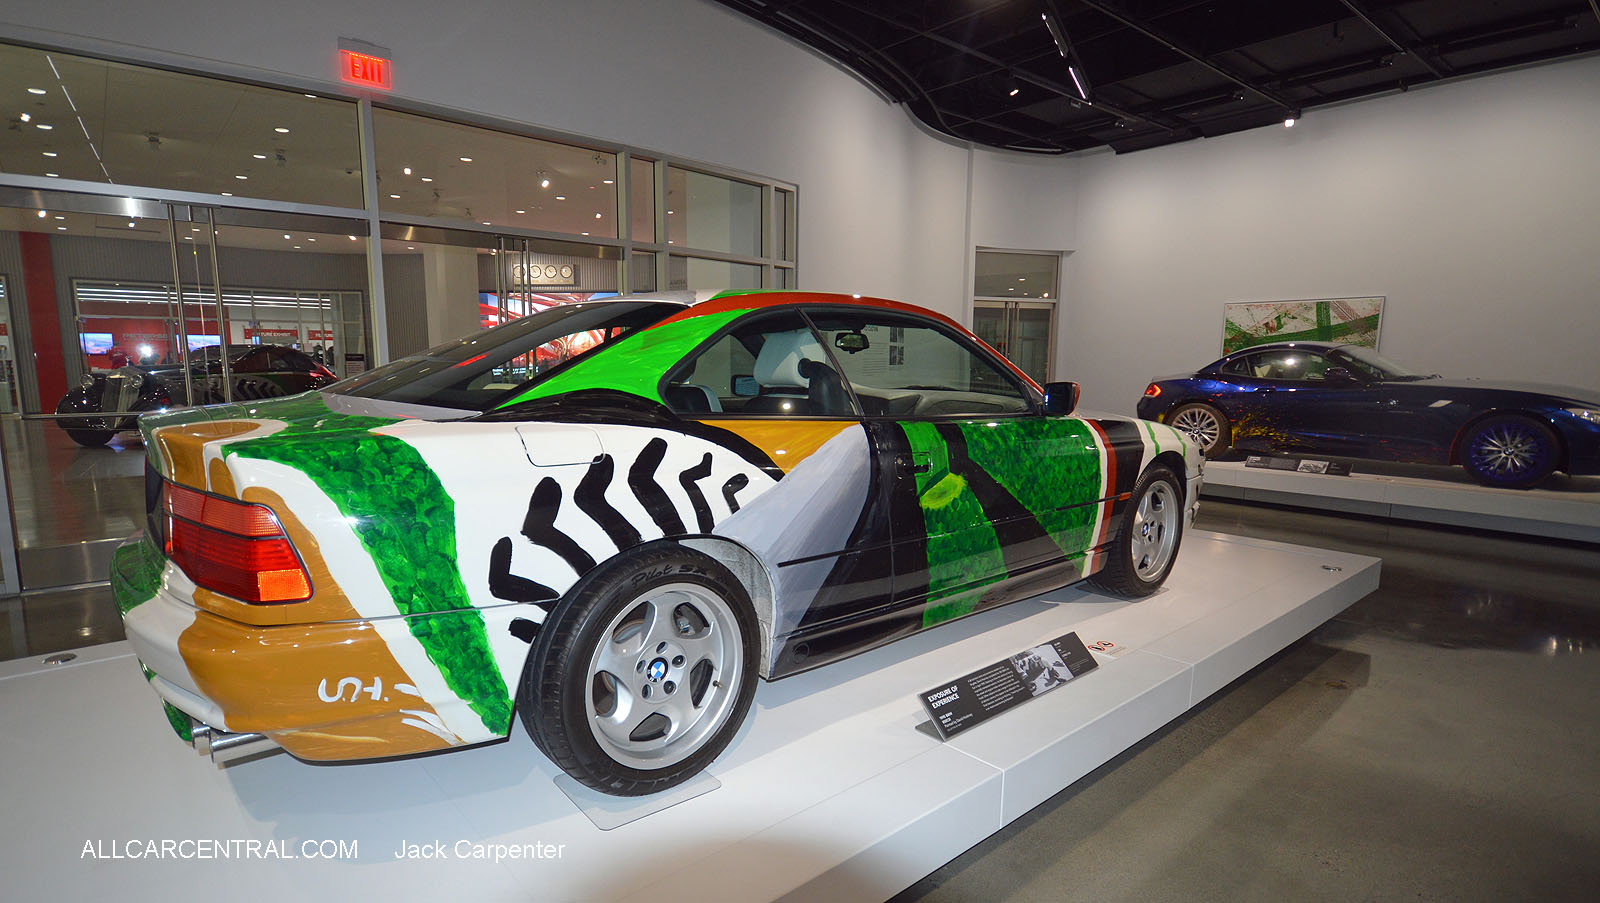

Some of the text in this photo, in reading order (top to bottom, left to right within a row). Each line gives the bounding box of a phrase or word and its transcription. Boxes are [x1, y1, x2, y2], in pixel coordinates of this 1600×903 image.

[350, 53, 383, 84] EXIT
[631, 564, 673, 585] Pilot
[928, 685, 958, 703] EXPOSURE OF
[931, 693, 960, 709] EXPERIENCE
